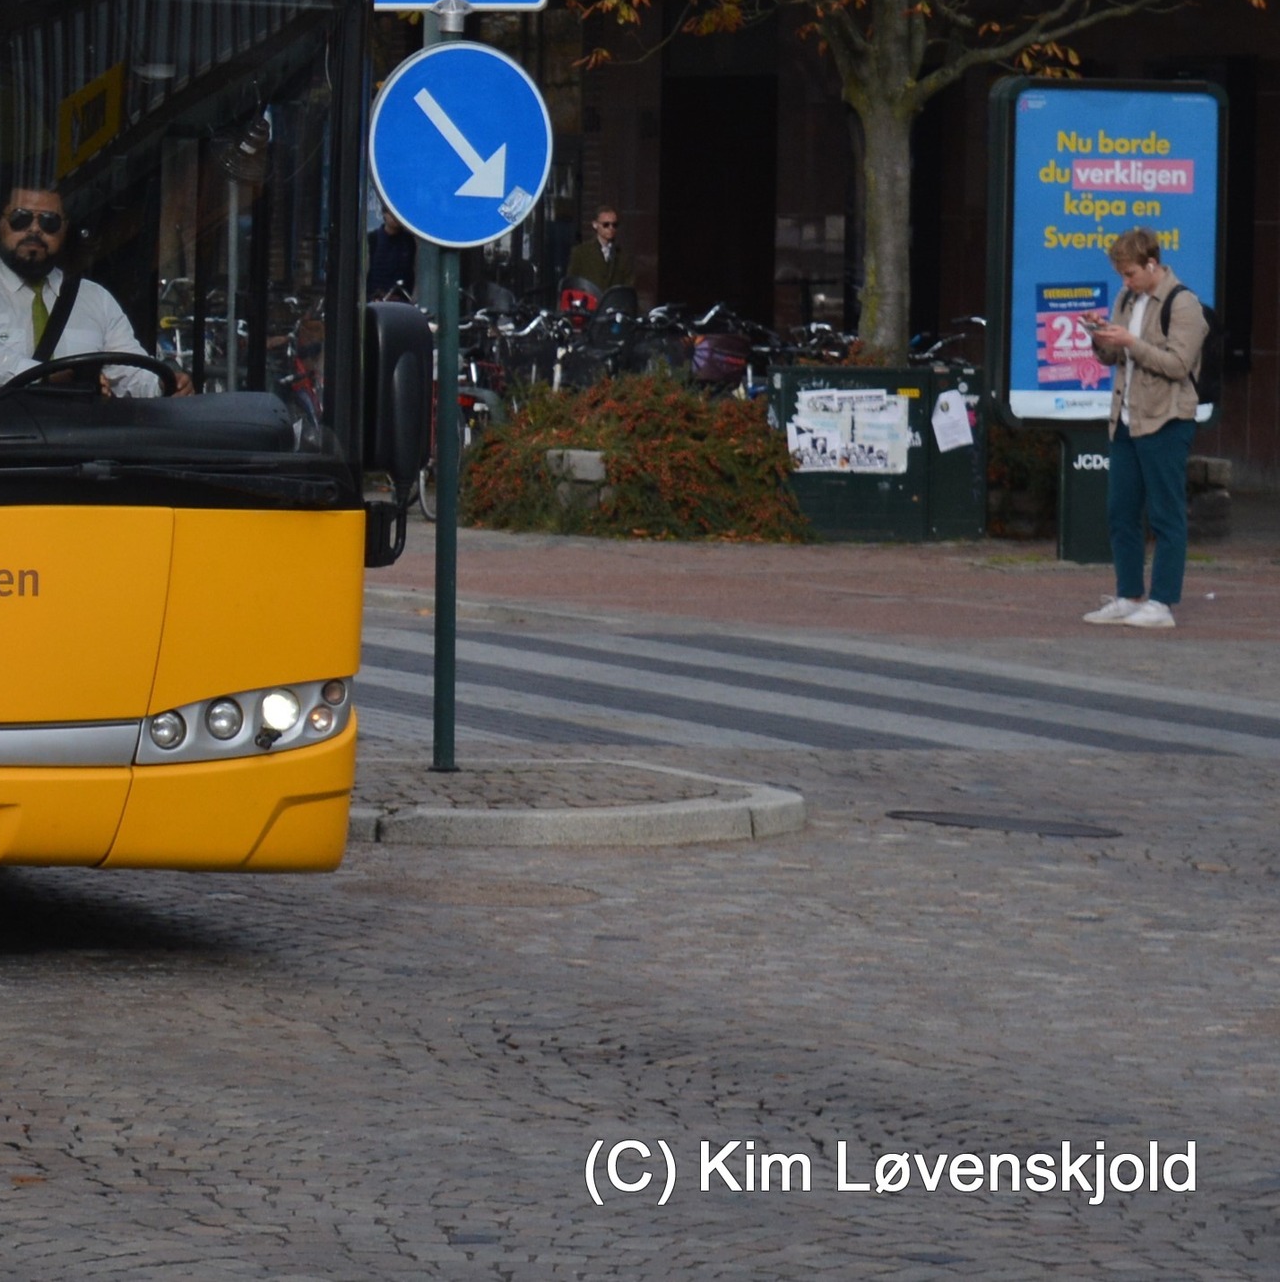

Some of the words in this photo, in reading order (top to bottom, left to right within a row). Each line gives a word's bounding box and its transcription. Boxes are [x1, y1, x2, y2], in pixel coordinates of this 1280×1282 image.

[1057, 130, 1092, 153] Nu
[1098, 129, 1171, 154] borde
[1039, 159, 1071, 183] du
[1076, 160, 1187, 192] verkligen
[1064, 191, 1127, 221] köpa
[1132, 200, 1161, 217] en
